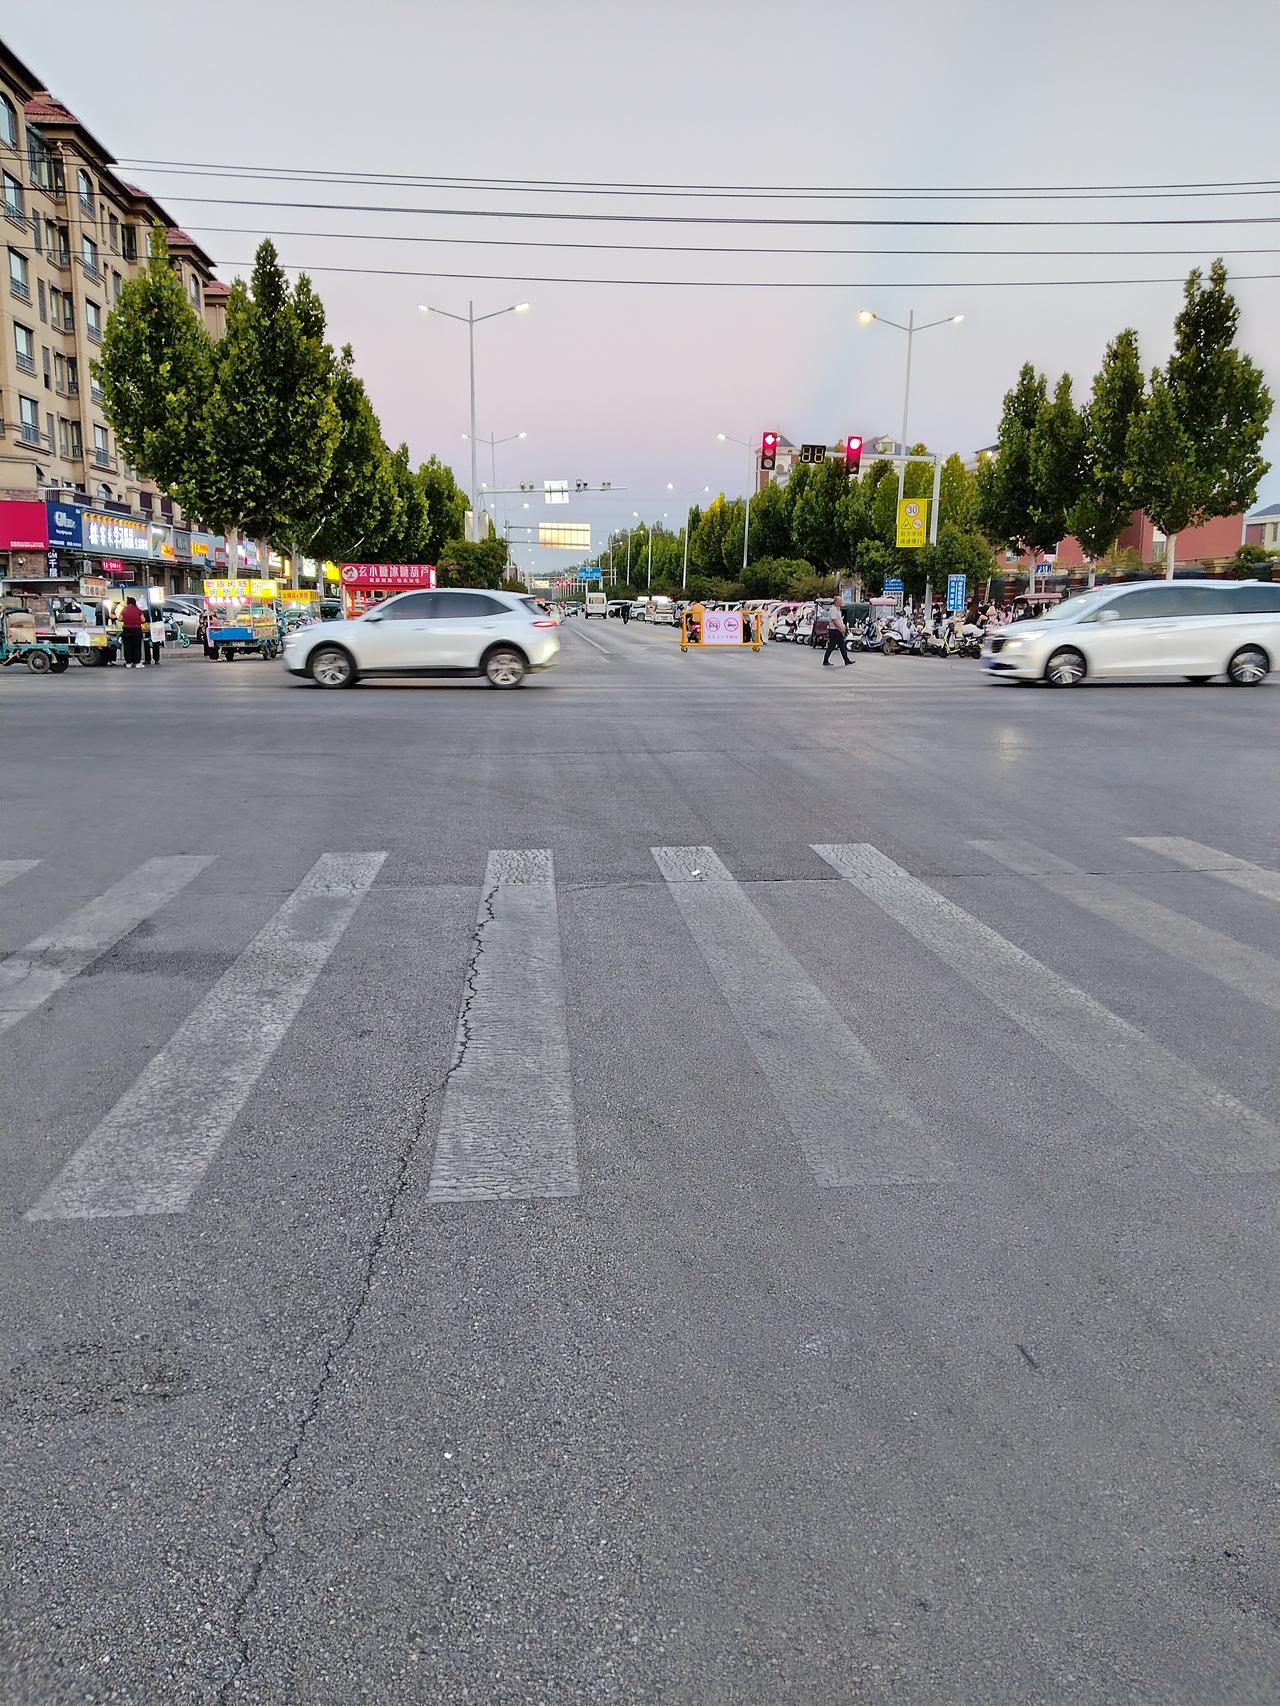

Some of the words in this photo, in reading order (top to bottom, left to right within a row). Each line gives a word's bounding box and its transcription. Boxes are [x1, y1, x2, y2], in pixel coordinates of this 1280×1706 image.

[907, 505, 918, 514] 30
[358, 565, 429, 578] 玄小糖冰糖葫芦
